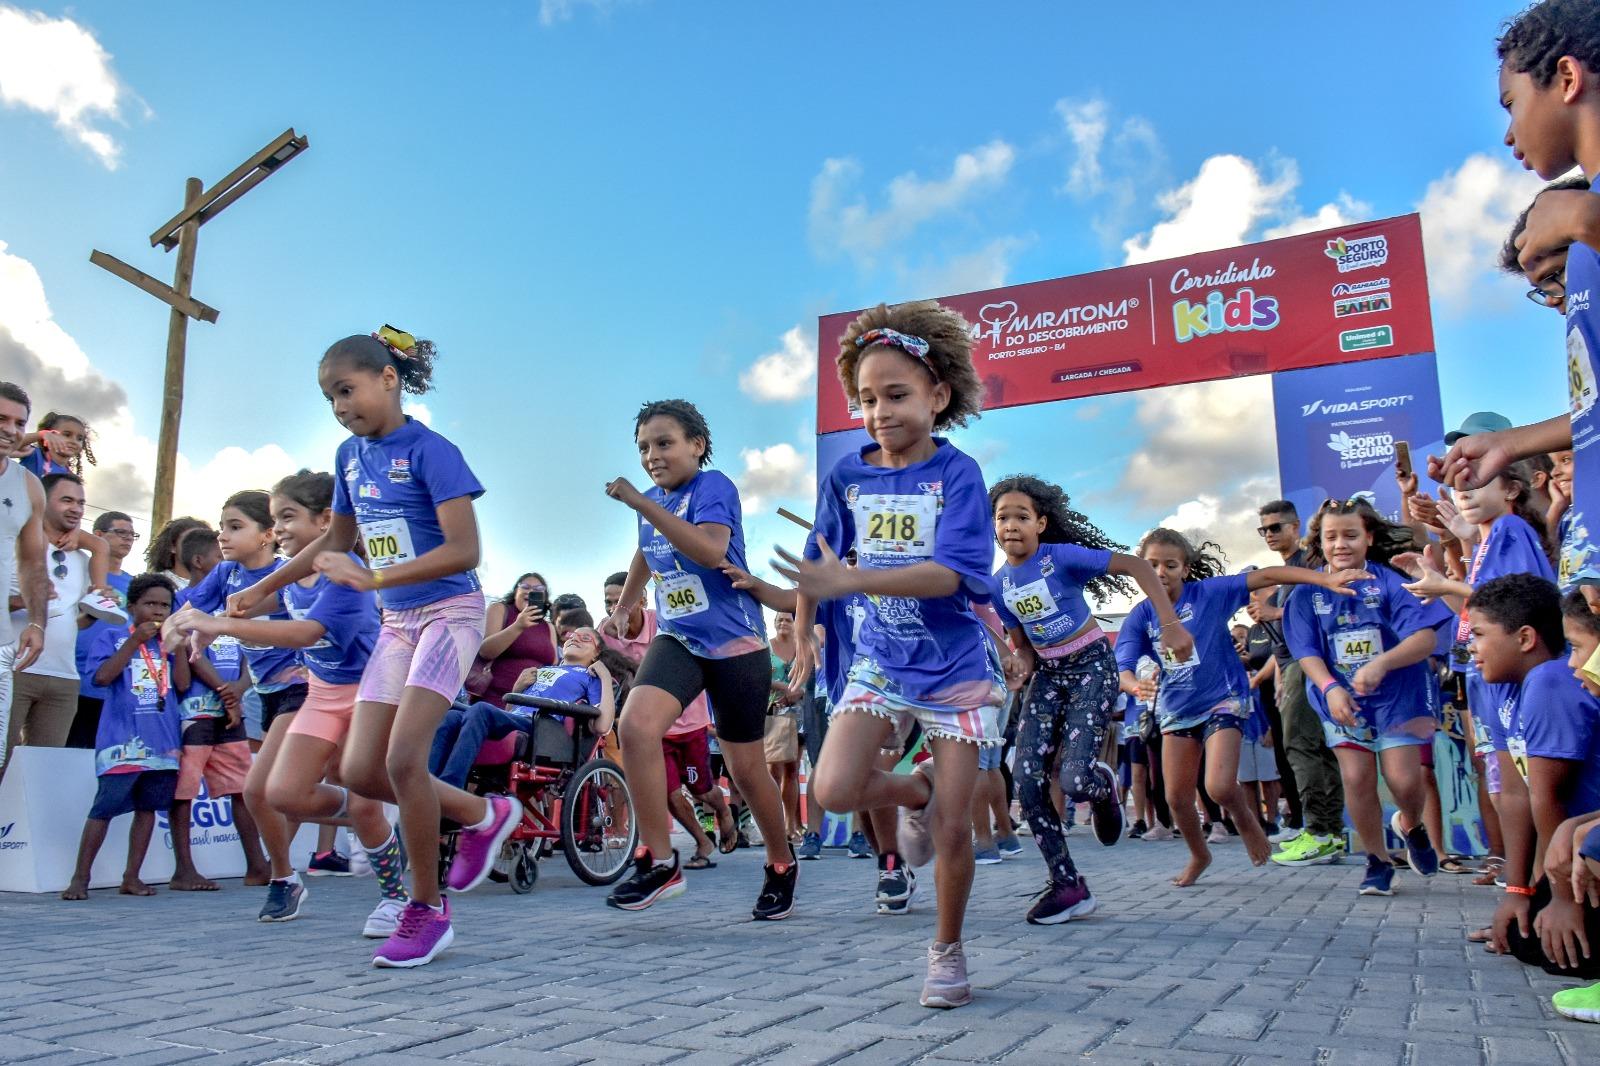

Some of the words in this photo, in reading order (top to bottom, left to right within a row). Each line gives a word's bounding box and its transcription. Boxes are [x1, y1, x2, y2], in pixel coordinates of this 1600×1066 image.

[1345, 240, 1385, 254] PORTO
[1338, 249, 1386, 265] SEGURO
[1170, 258, 1276, 294] Corridinha
[1173, 287, 1280, 343] kids
[1336, 298, 1389, 316] BAHIA
[1006, 334, 1024, 347] DO
[1028, 319, 1128, 344] DESCOBRIMENTO
[1345, 331, 1376, 342] Unimed
[988, 350, 1016, 361] PORTO
[1017, 345, 1047, 358] SEGURO
[1054, 342, 1066, 351] BA
[1060, 371, 1093, 382] LARGADA
[1098, 365, 1132, 377] CHEGADA
[1348, 434, 1393, 449] PORTO
[1340, 444, 1394, 460] SEGURO
[870, 513, 915, 541] 218
[369, 536, 397, 557] 070
[667, 589, 695, 608] 346
[1016, 595, 1043, 615] 053
[1345, 641, 1371, 655] 447
[539, 670, 555, 679] 140
